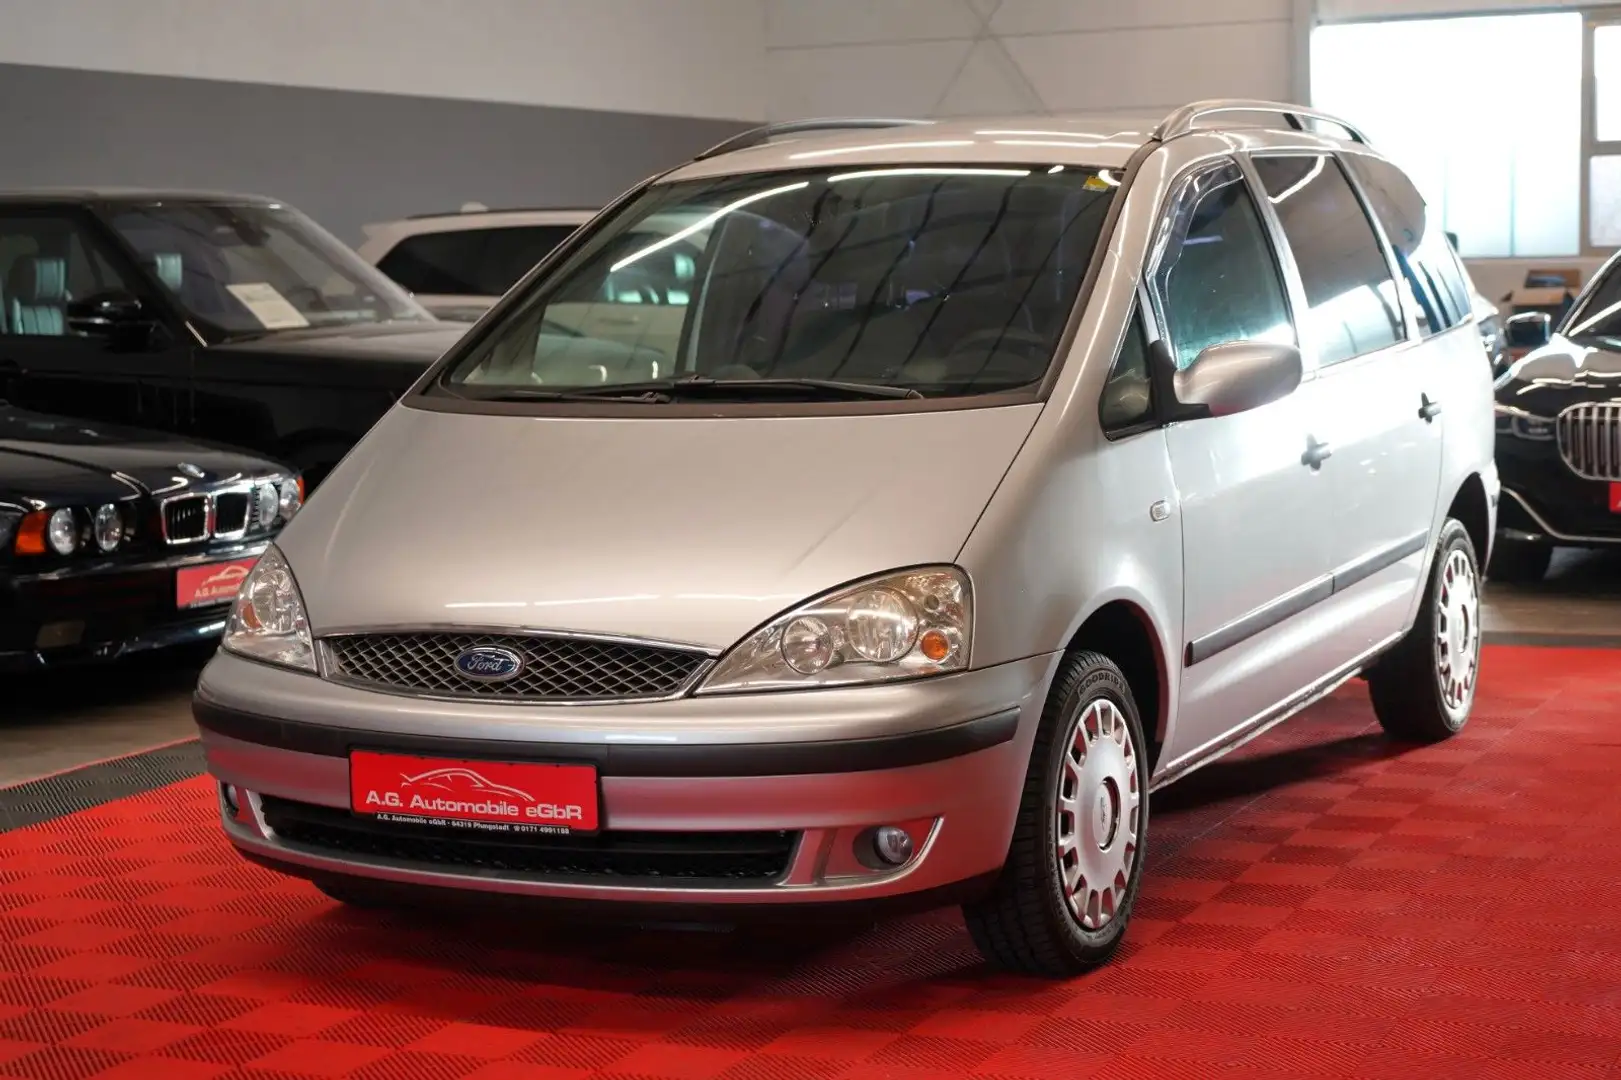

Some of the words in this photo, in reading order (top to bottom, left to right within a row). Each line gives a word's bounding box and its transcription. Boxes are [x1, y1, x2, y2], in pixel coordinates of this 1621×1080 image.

[467, 653, 510, 671] Ford
[365, 790, 404, 807] A.G.
[410, 794, 519, 816] Automobile
[525, 803, 582, 819] eGbR
[392, 815, 427, 824] Automobile
